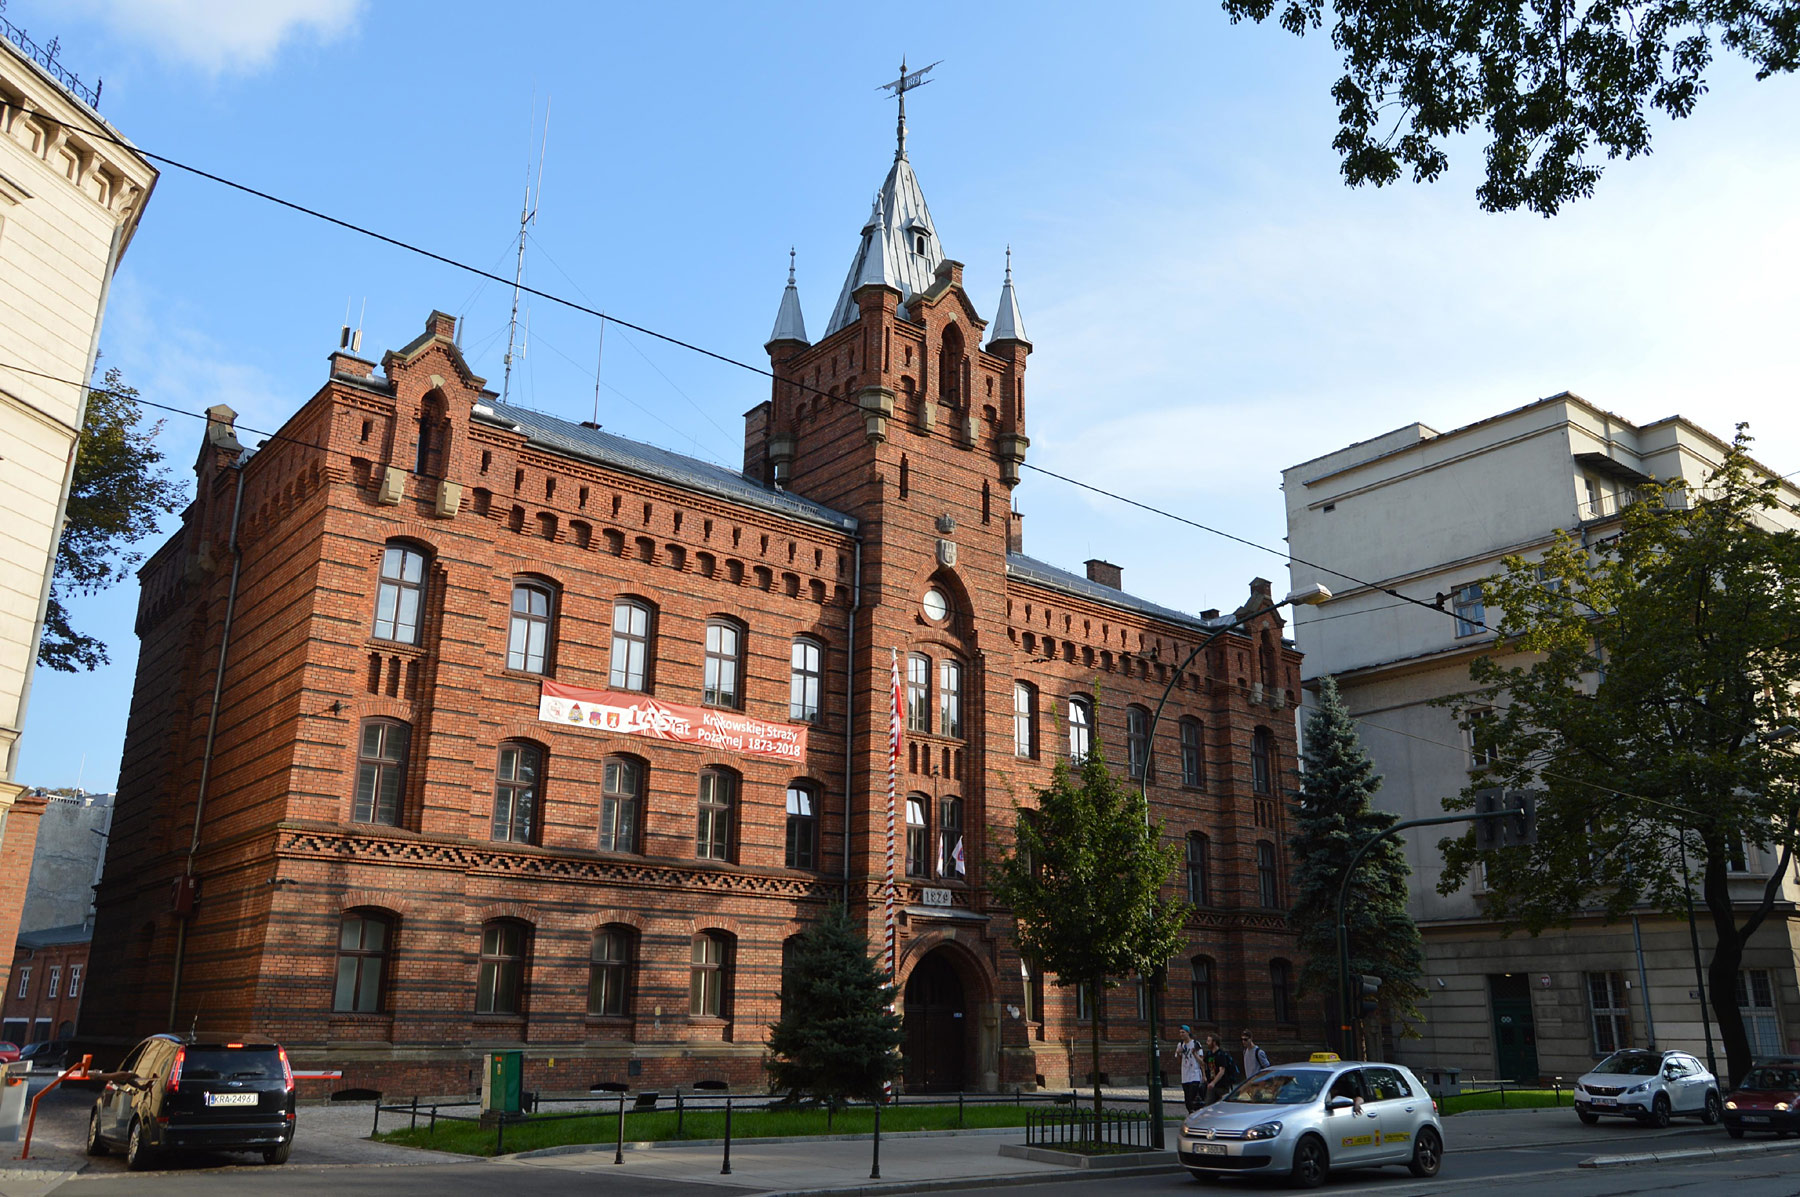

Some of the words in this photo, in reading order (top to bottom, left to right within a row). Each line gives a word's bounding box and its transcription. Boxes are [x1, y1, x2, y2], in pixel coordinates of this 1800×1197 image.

[671, 719, 690, 735] lat
[766, 726, 798, 742] Straży
[697, 728, 743, 749] Pożarnej
[748, 738, 801, 757] 1873-2018
[214, 1095, 230, 1104] KRA
[232, 1094, 257, 1104] 2496J
